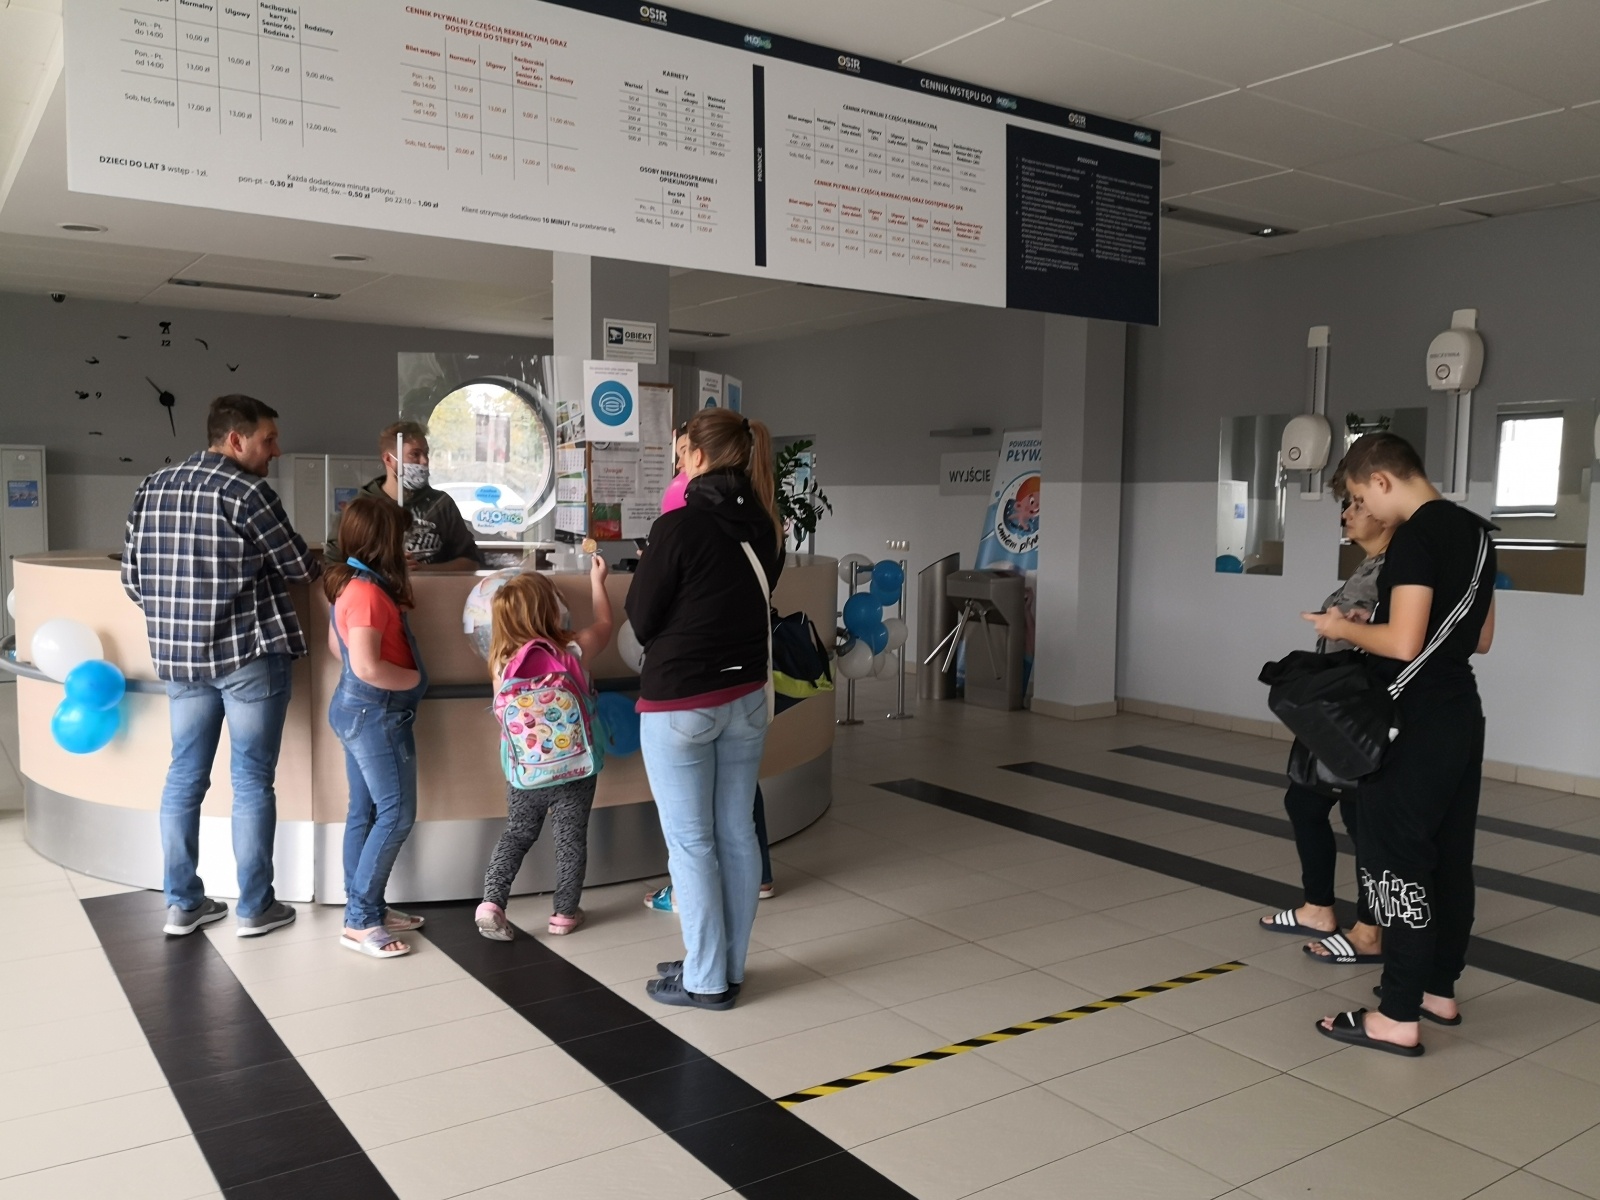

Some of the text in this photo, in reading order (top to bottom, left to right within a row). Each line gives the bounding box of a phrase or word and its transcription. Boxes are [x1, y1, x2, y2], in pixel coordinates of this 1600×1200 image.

[180, 0, 213, 11] Normalny
[260, 2, 297, 15] Raciborskie
[225, 8, 251, 19] Ulgowy
[270, 12, 288, 22] karty:
[134, 19, 147, 27] Pon.
[262, 20, 283, 28] Senior
[406, 6, 432, 17] CENNIK
[434, 12, 468, 25] PŁYWALNI
[475, 20, 502, 34] CZĘŚCIĄ
[504, 28, 548, 45] REKREACYJNĄ
[550, 38, 567, 48] ORAZ
[146, 30, 163, 39] 14:00
[264, 28, 289, 38] Rodzina
[304, 24, 334, 36] Rodzinny
[186, 33, 202, 42] 10,00
[445, 24, 532, 49] DOSTĘPEM DO STREFY SPA
[134, 50, 149, 58] Pon.
[406, 44, 440, 57] Bilet wstępu
[147, 60, 164, 69] 14:00
[228, 57, 244, 65] 10,00
[450, 54, 476, 65] Normalny
[514, 56, 544, 67] Raciborskie
[187, 63, 203, 71] 13,00
[271, 64, 283, 73] 7,00
[486, 61, 506, 72] Ulgowy
[306, 71, 318, 79] 9,00
[516, 71, 532, 79] Senior
[550, 74, 574, 85] Rodzinny
[662, 70, 689, 81] KARNETY
[517, 79, 538, 88] Rodzina
[624, 81, 643, 90] Wartość
[920, 78, 949, 94] CENNIK
[950, 86, 980, 101] WSTĘPU
[981, 94, 992, 104] DO
[124, 93, 140, 103] Sob,
[154, 97, 175, 108] Święta
[188, 103, 204, 112] 17,00
[229, 110, 245, 119] 13,00
[272, 117, 288, 126] 10,00
[306, 122, 322, 132] 12,00
[100, 156, 127, 167] DZIECI
[130, 160, 142, 168] DO
[144, 162, 160, 171] LAT
[161, 164, 166, 172] 3
[168, 166, 190, 176] wstęp
[640, 166, 715, 184] OSOBY NIEPEŁNOSPRAWNE
[238, 175, 263, 185] pon-pt
[270, 180, 286, 188] 0,30
[287, 174, 396, 196] Każda dodatkowa minuta pobytu:
[660, 176, 699, 188] OPIEKUNOWIE
[309, 185, 330, 195] sb-nd,
[348, 190, 363, 199] 0,50
[385, 196, 393, 204] po
[418, 200, 432, 208] 1,00
[462, 206, 478, 214] Klient
[480, 208, 509, 219] otrzymuje
[510, 212, 541, 223] dodatkowo
[550, 218, 571, 226] MINUT
[580, 222, 607, 232] przebranie
[625, 332, 652, 341] OBIEKT
[165, 456, 171, 464] 6
[1006, 449, 1041, 462] PŁYW
[950, 466, 991, 483] WYJŚCIE
[528, 764, 568, 782] Donut
[552, 766, 586, 781] worry
